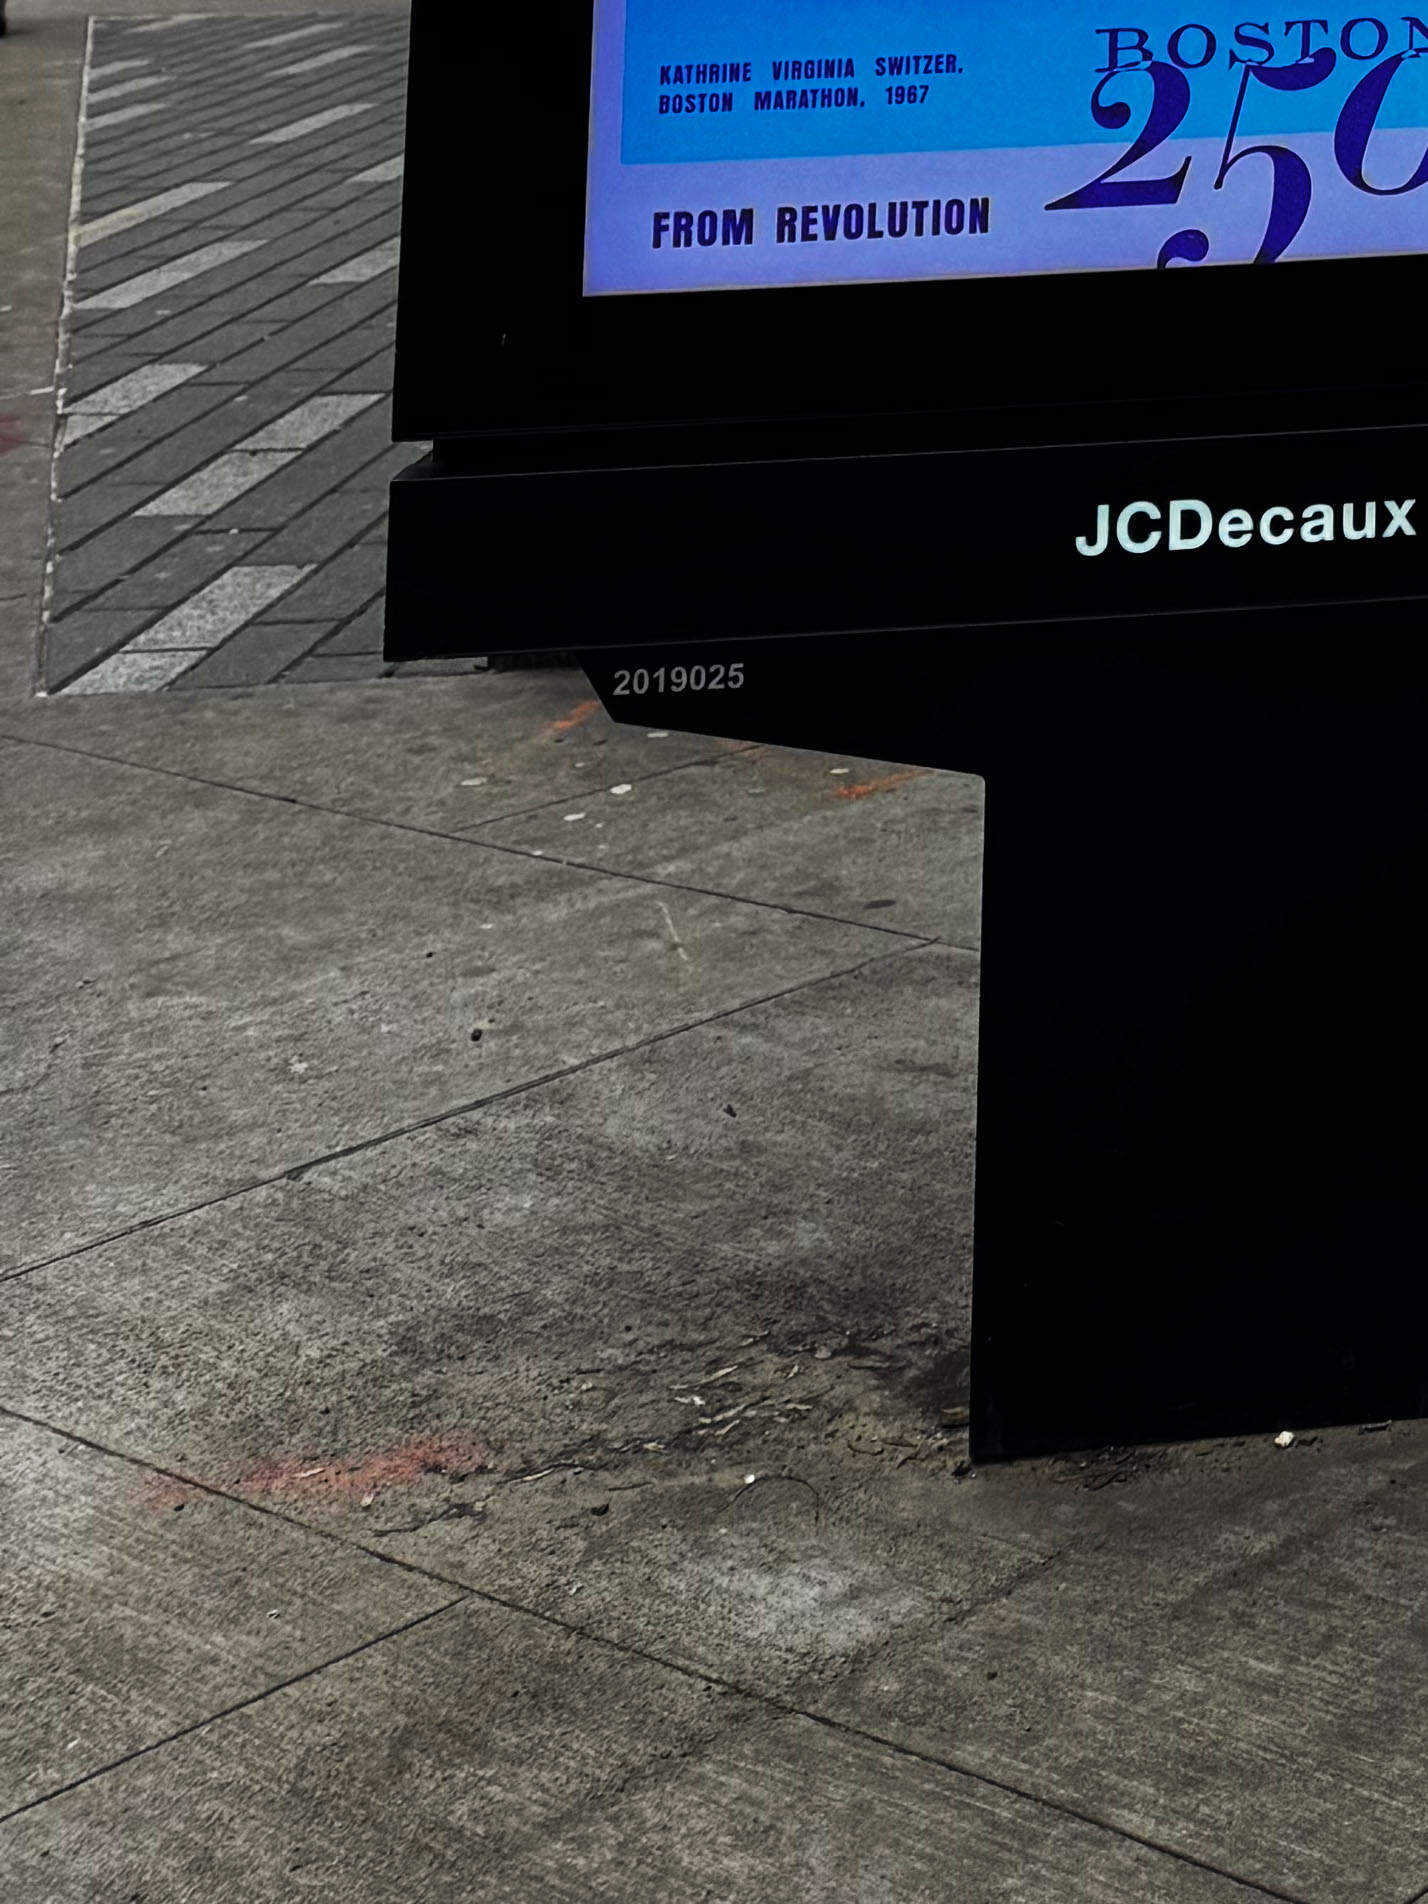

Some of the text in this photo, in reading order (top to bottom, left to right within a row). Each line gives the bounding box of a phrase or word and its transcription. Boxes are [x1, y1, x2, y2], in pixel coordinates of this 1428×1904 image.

[659, 61, 752, 86] KATHRINE
[771, 57, 855, 81] VIRGINIA
[658, 84, 930, 115] BOSTON MARATHON, 1967
[652, 197, 990, 249] FROM REVOLUTION
[1075, 498, 1417, 557] JCDecaux
[612, 662, 745, 697] 2019025
